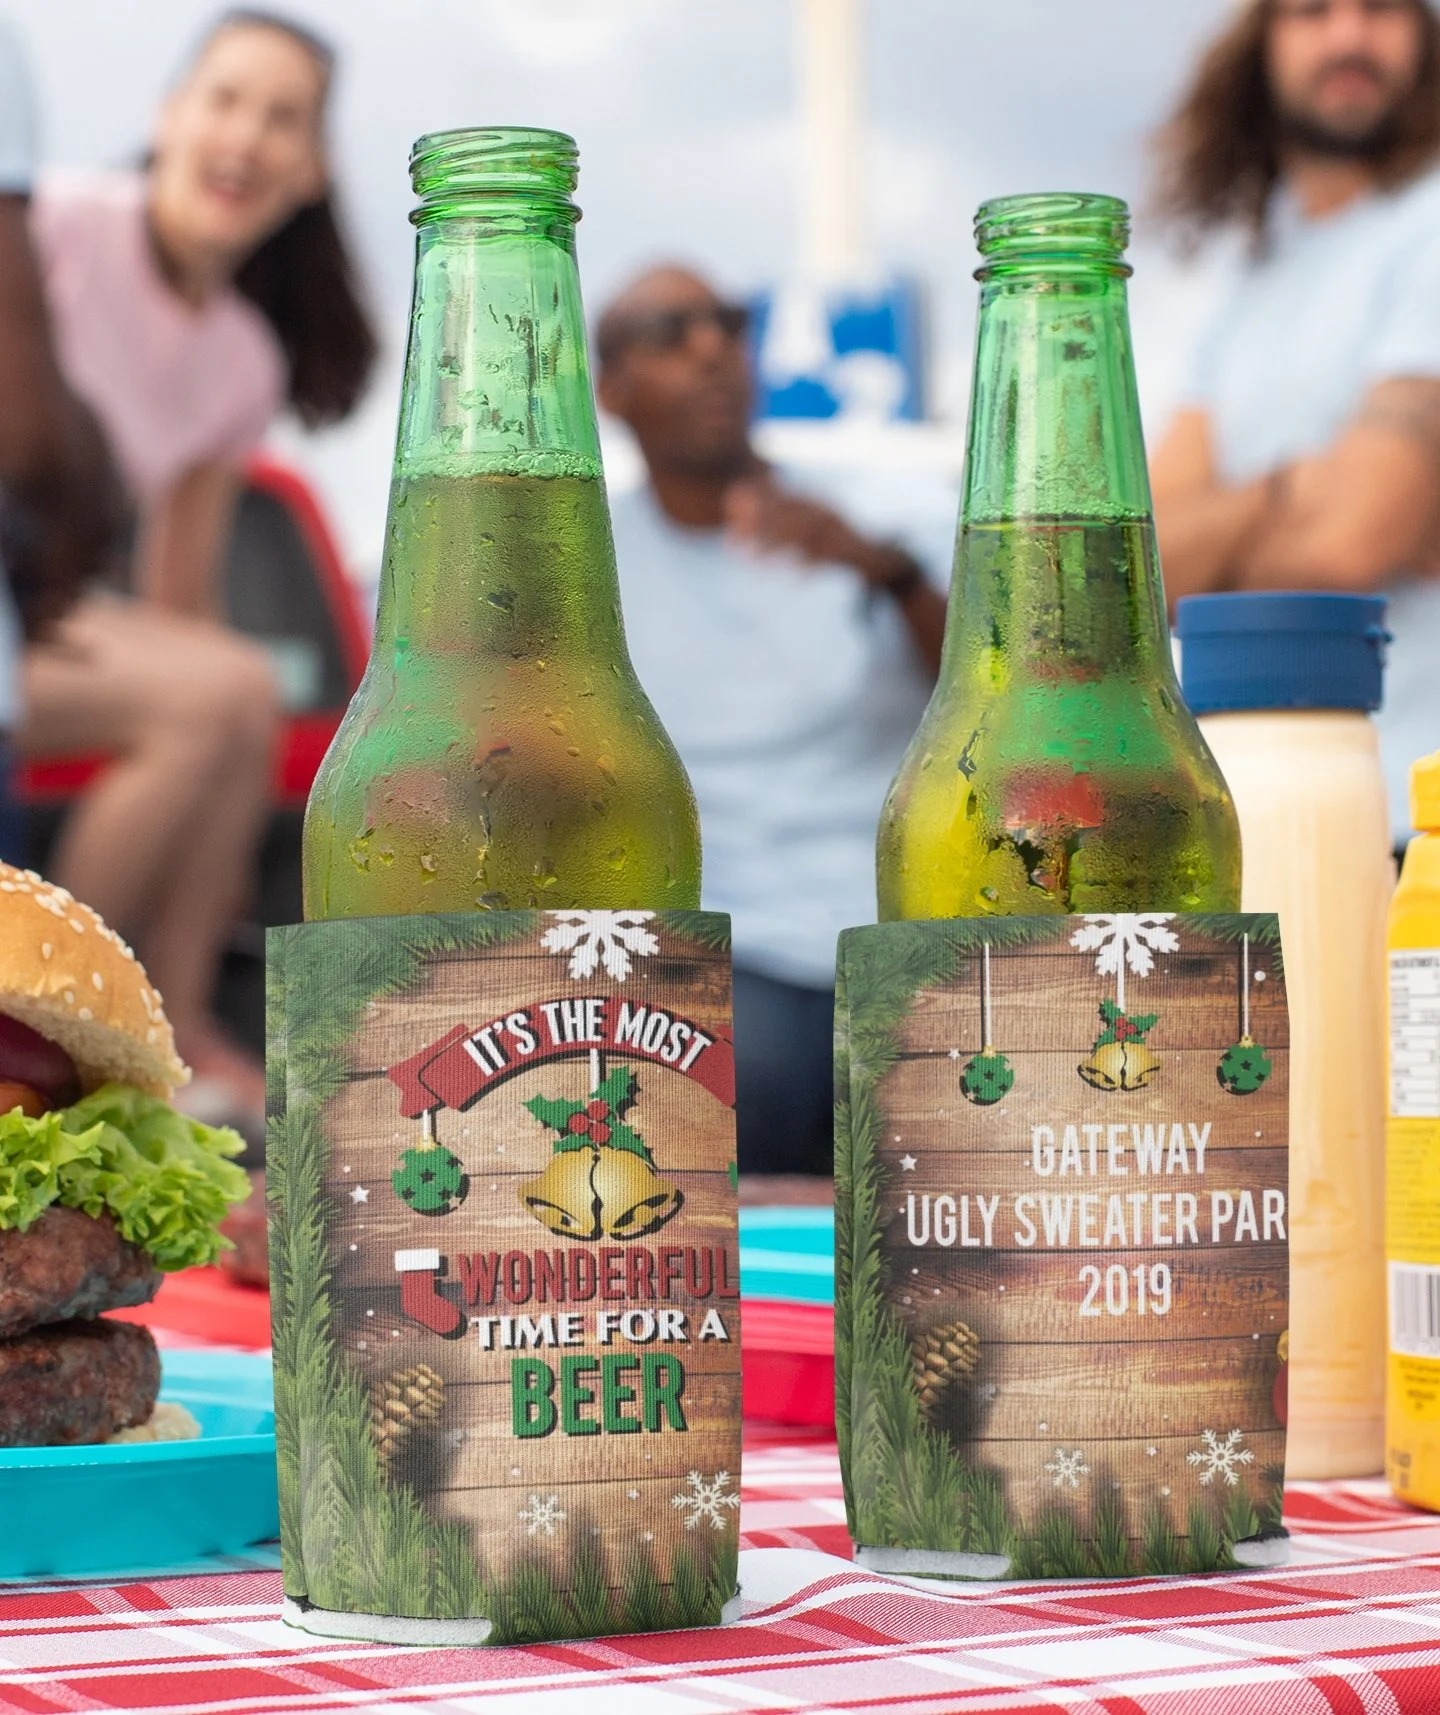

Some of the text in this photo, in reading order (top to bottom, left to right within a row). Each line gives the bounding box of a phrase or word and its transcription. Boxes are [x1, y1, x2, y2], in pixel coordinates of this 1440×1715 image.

[463, 999, 712, 1077] IT'S THE MOST
[1031, 1122, 1212, 1176] GATEWAY
[907, 1194, 1000, 1246] UGLY
[1014, 1193, 1199, 1247] SWEATER
[457, 1246, 740, 1305] WONDERFUL
[1078, 1262, 1172, 1316] 2019
[472, 1309, 730, 1349] TIME FOR A
[511, 1353, 688, 1438] BEER
